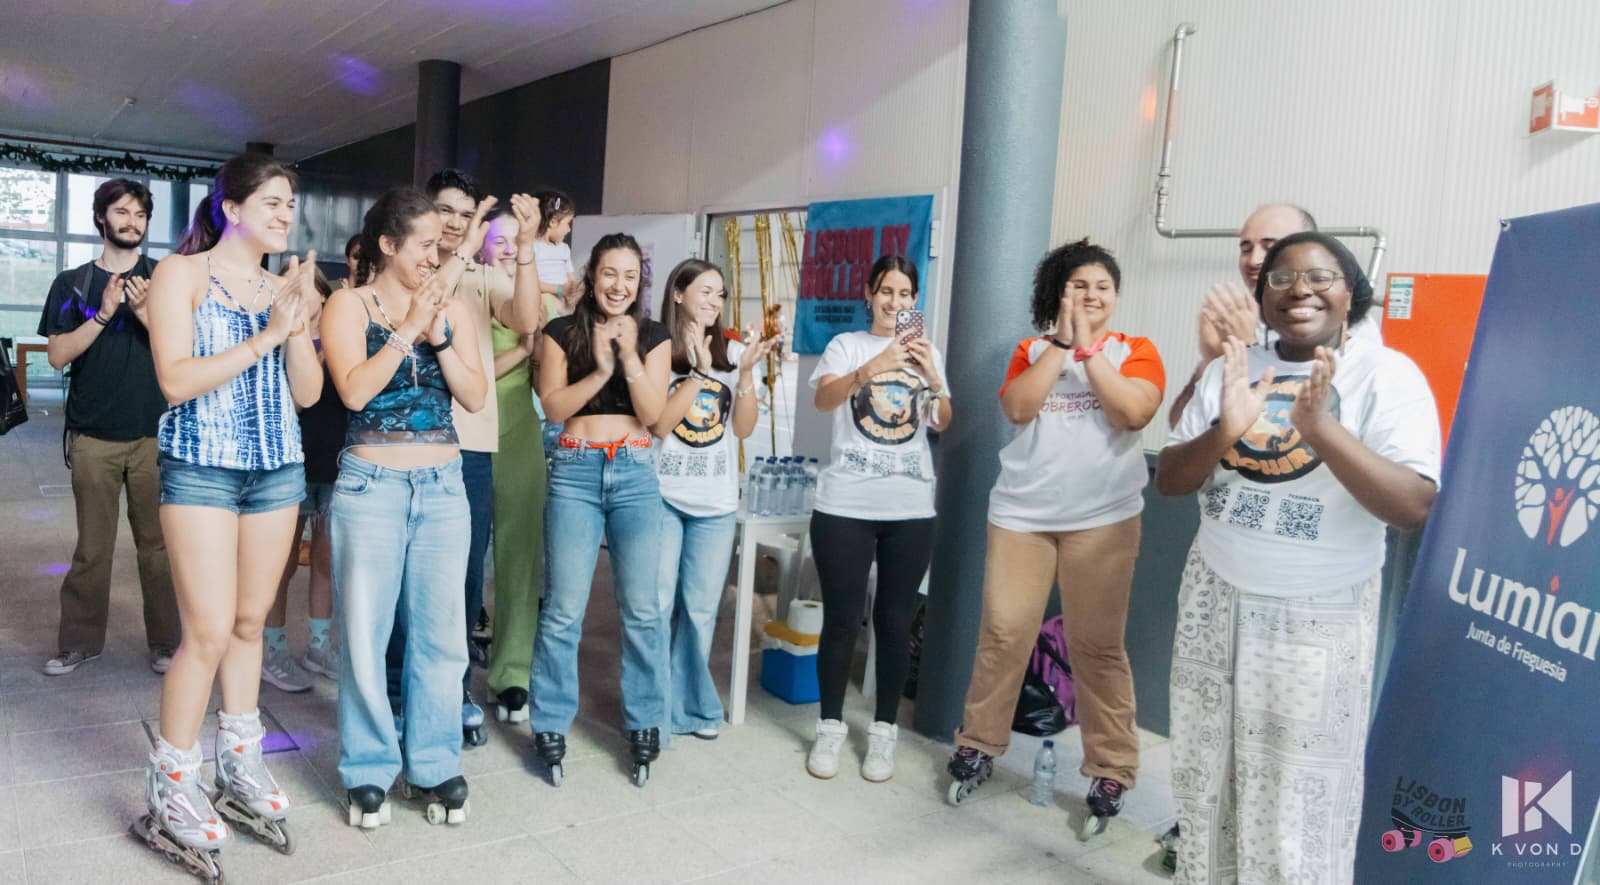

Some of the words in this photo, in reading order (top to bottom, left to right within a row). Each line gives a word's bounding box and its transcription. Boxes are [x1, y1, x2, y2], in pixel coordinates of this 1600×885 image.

[804, 227, 876, 264] LISBON
[881, 224, 911, 257] BY
[674, 424, 724, 443] ROLLER
[860, 416, 914, 440] ROLLER
[1465, 622, 1496, 648] Junta
[1496, 636, 1512, 655] de
[1511, 642, 1567, 682] Freguesia
